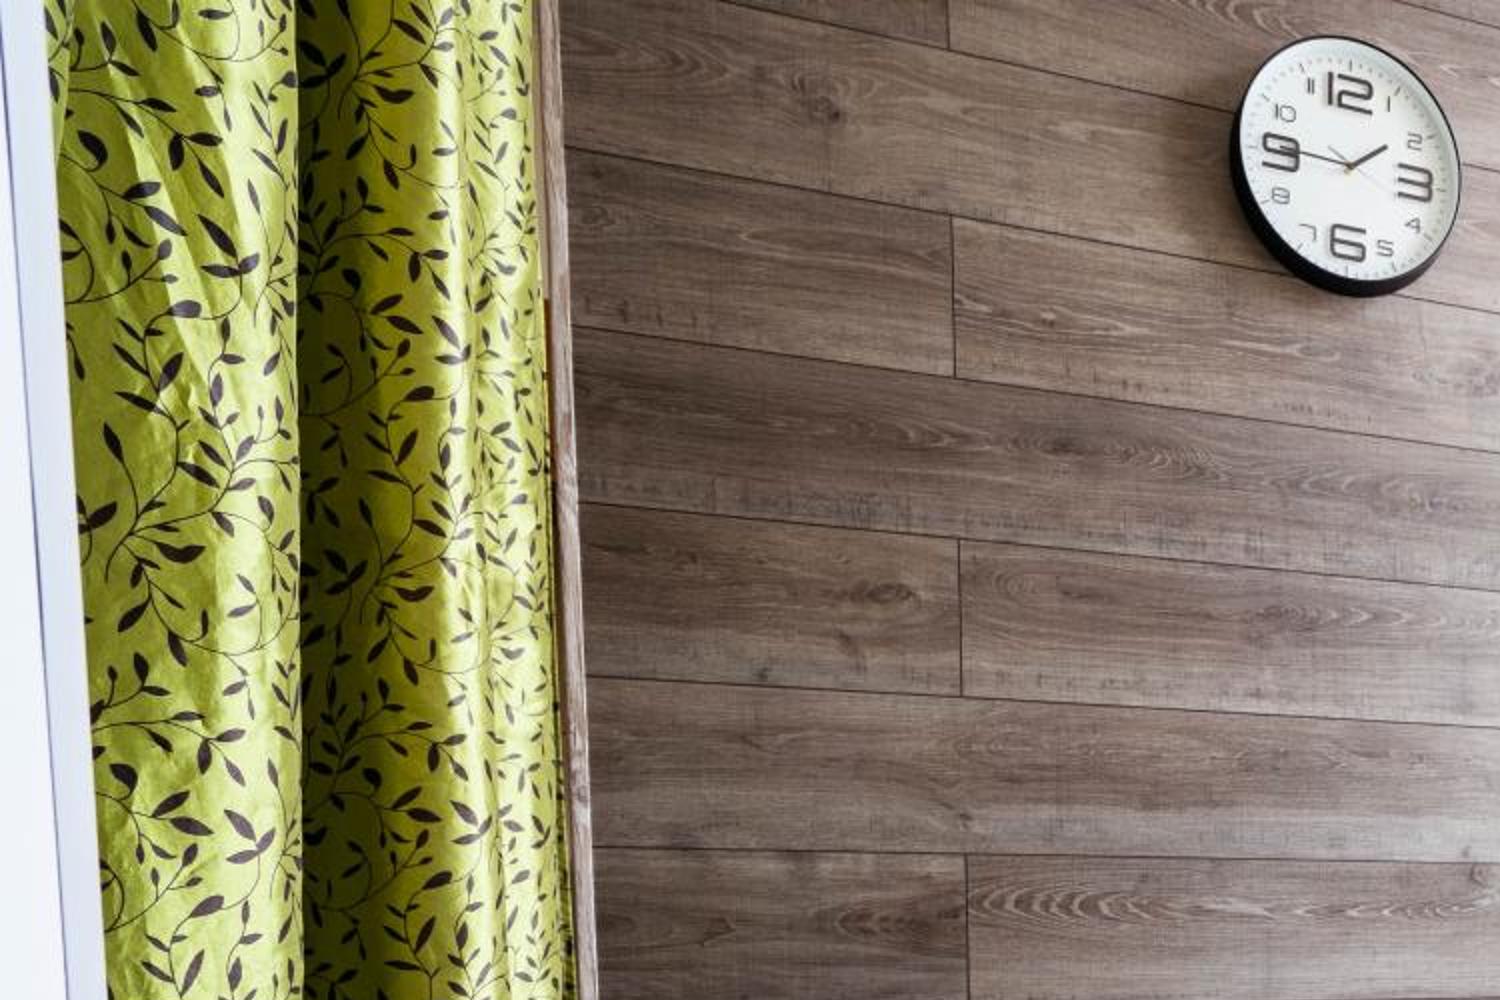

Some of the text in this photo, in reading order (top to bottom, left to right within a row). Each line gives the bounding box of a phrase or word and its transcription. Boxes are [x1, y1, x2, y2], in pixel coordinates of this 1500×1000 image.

[1306, 76, 1316, 95] 11
[1326, 71, 1374, 115] 12
[1275, 103, 1297, 123] 10
[1406, 132, 1424, 151] 2
[1261, 131, 1301, 173] 9
[1397, 162, 1434, 203] 3
[1271, 186, 1291, 205] 8
[1299, 223, 1318, 242] 7
[1405, 216, 1422, 234] 4
[1329, 222, 1367, 263] 6
[1376, 238, 1395, 258] 5
